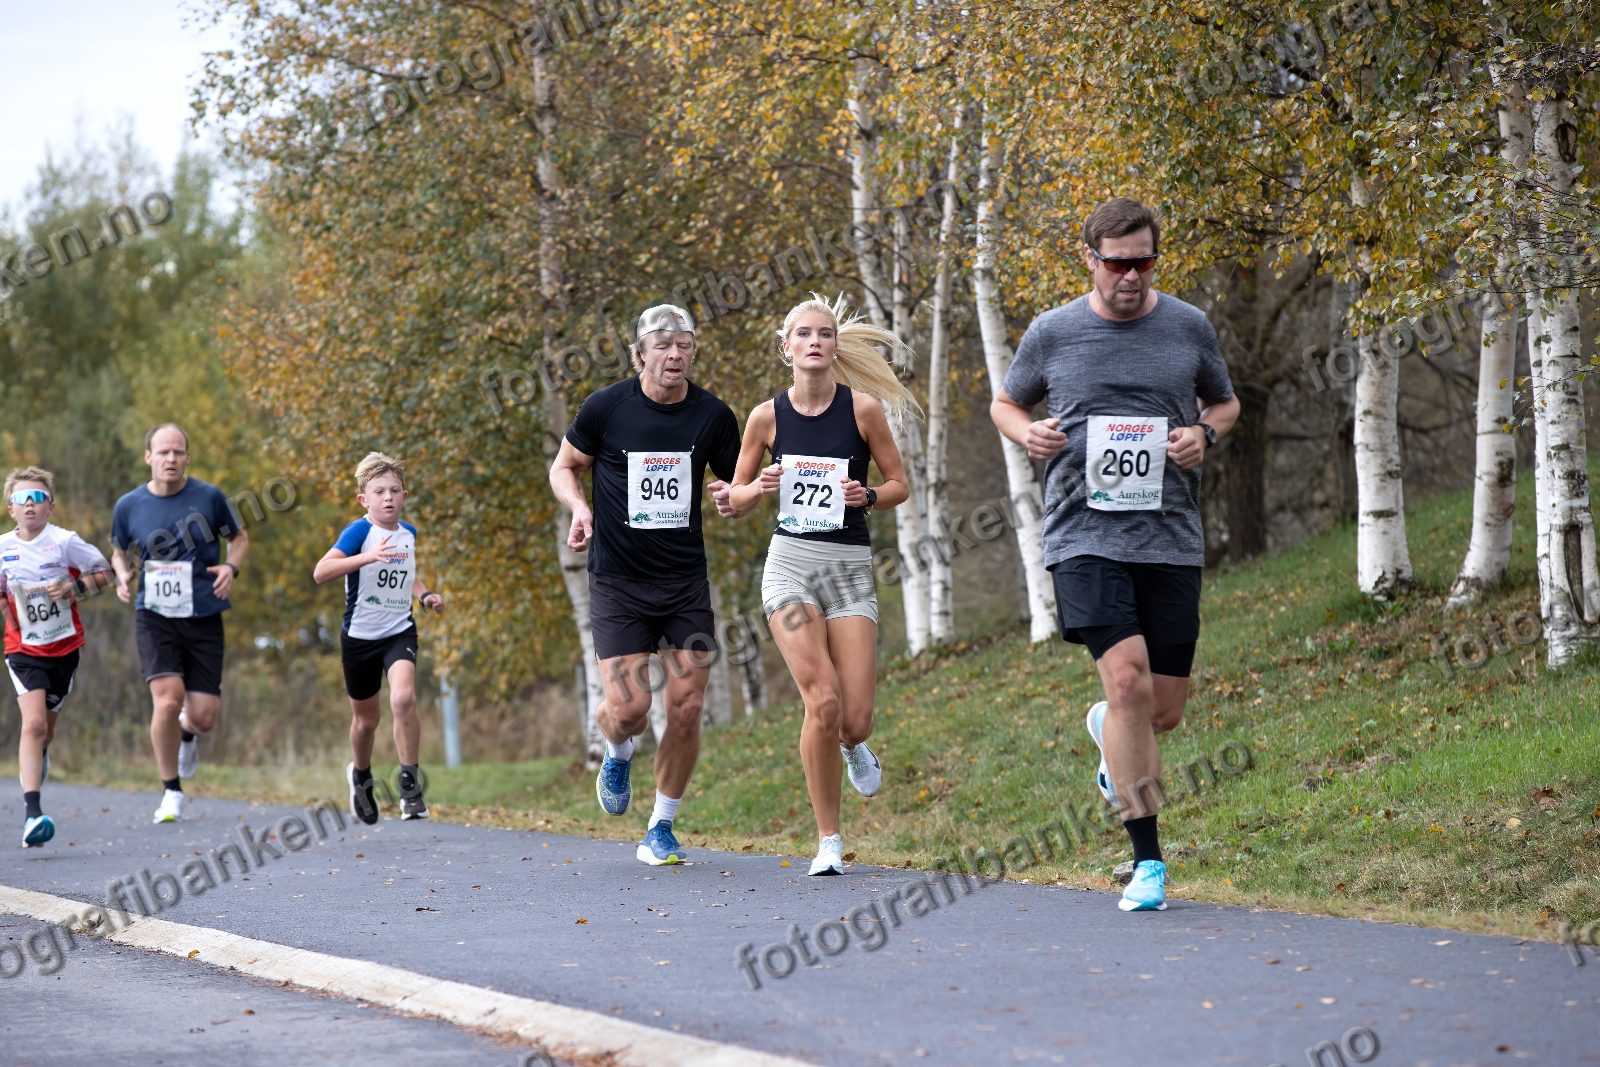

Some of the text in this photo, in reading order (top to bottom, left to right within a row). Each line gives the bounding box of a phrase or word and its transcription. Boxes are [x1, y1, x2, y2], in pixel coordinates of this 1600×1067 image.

[1107, 424, 1154, 433] NORGES
[1110, 433, 1146, 442] LØPET
[643, 457, 681, 465] NORGES
[795, 461, 836, 471] NORGES
[1102, 449, 1150, 477] 260
[798, 469, 829, 477] LØPET
[641, 477, 679, 501] 946
[792, 481, 833, 508] 272
[1117, 489, 1160, 500] Aurskog
[655, 510, 689, 519] Aurskog
[803, 517, 840, 529] Aurskog
[377, 568, 408, 589] 967
[154, 581, 182, 597] 104
[26, 601, 61, 623] 864
